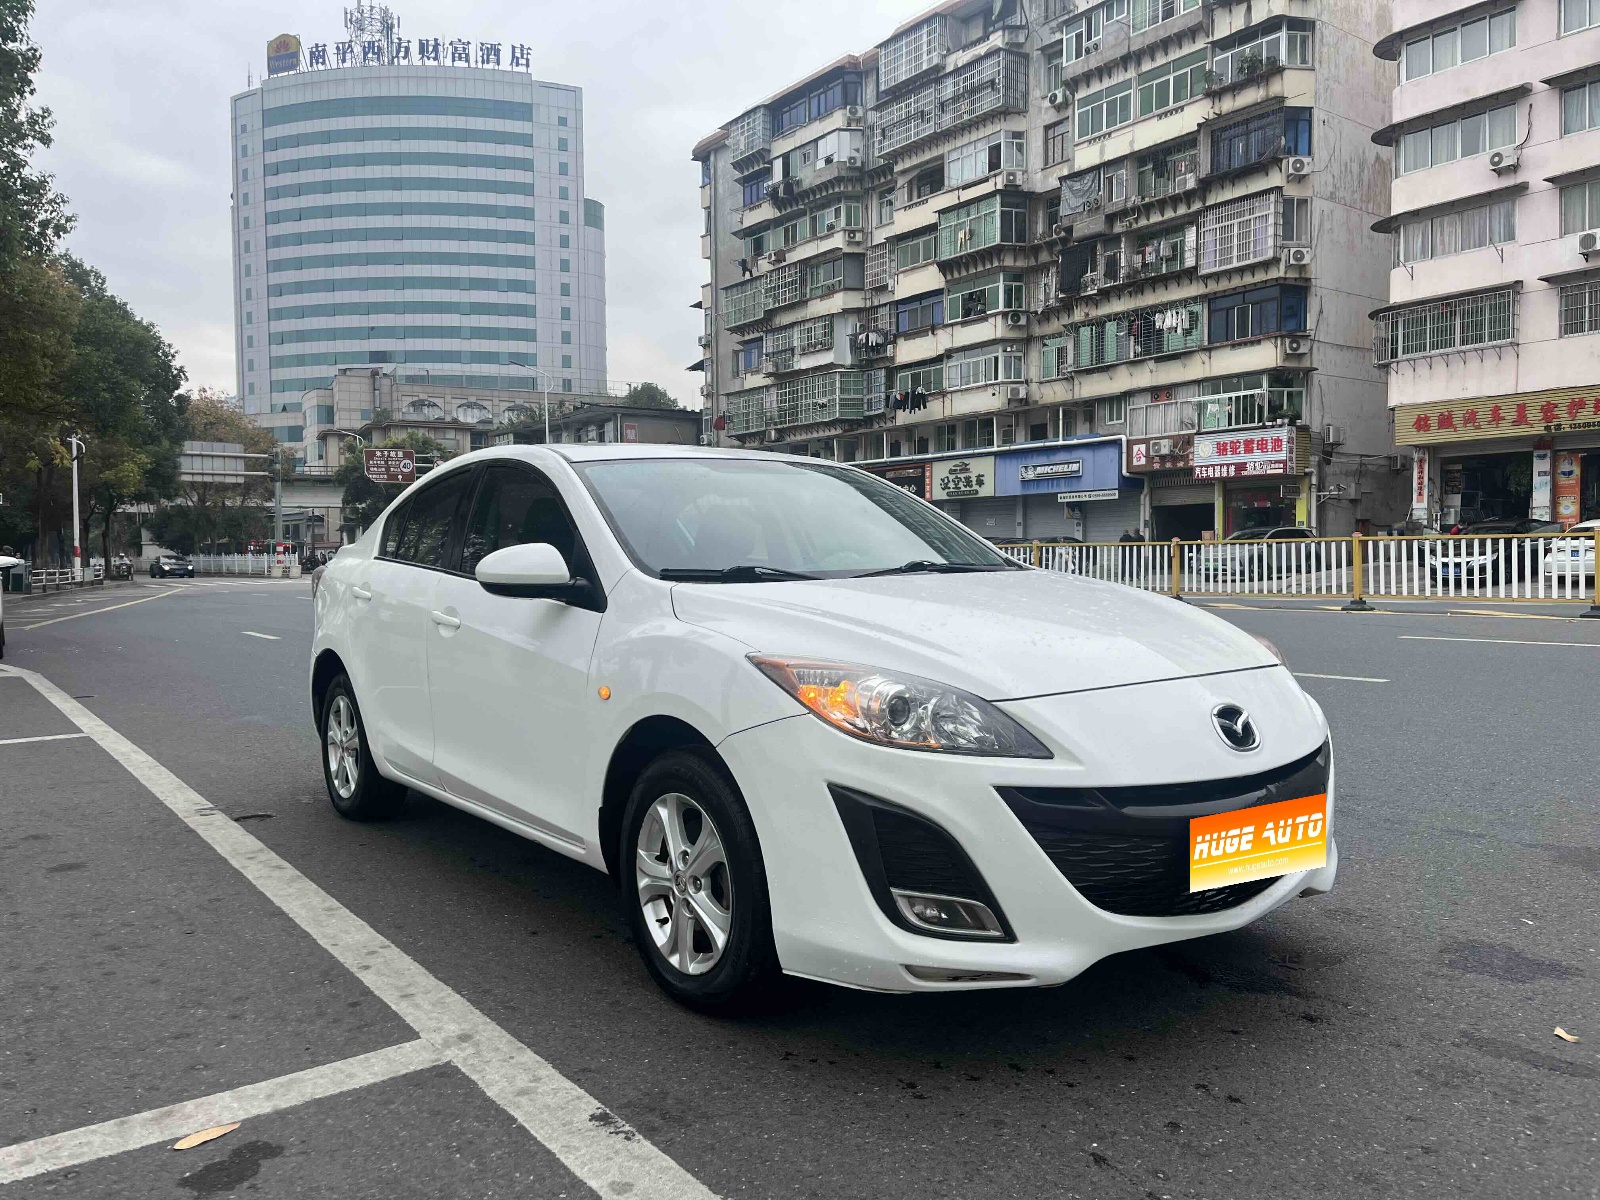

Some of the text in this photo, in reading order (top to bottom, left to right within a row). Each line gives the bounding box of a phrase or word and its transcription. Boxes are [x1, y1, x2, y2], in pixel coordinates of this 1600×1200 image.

[307, 37, 532, 68] 南平西方财富酒店
[1216, 436, 1283, 456] 骆驼蓄电池
[402, 462, 411, 470] 40
[1035, 463, 1080, 474] MICHELIN
[1194, 464, 1236, 479] 汽车电器维修
